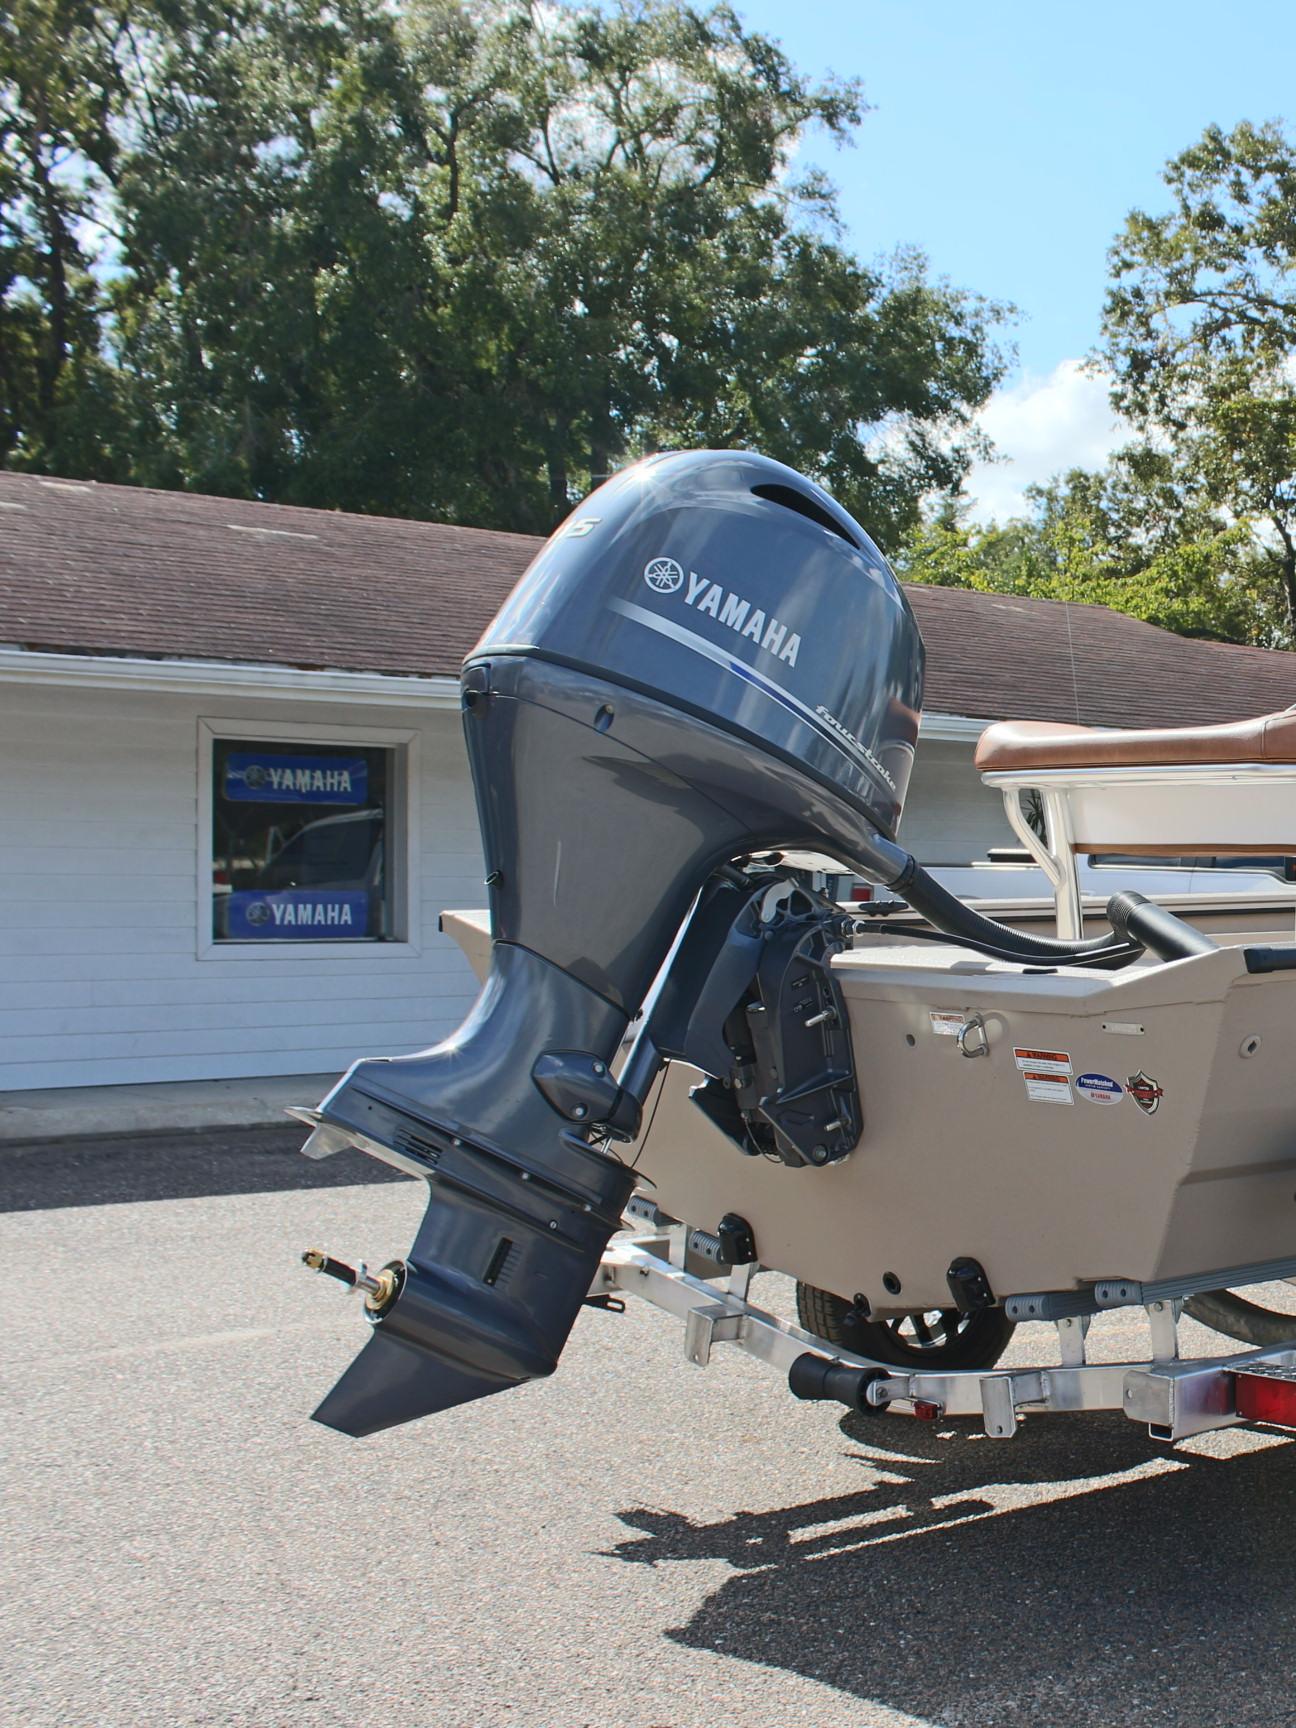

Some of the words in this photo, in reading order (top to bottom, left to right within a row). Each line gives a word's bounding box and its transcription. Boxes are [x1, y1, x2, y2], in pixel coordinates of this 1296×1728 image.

[684, 571, 801, 668] YAMAHA
[270, 767, 352, 792] YAMAHA
[271, 903, 352, 925] YAMAHA
